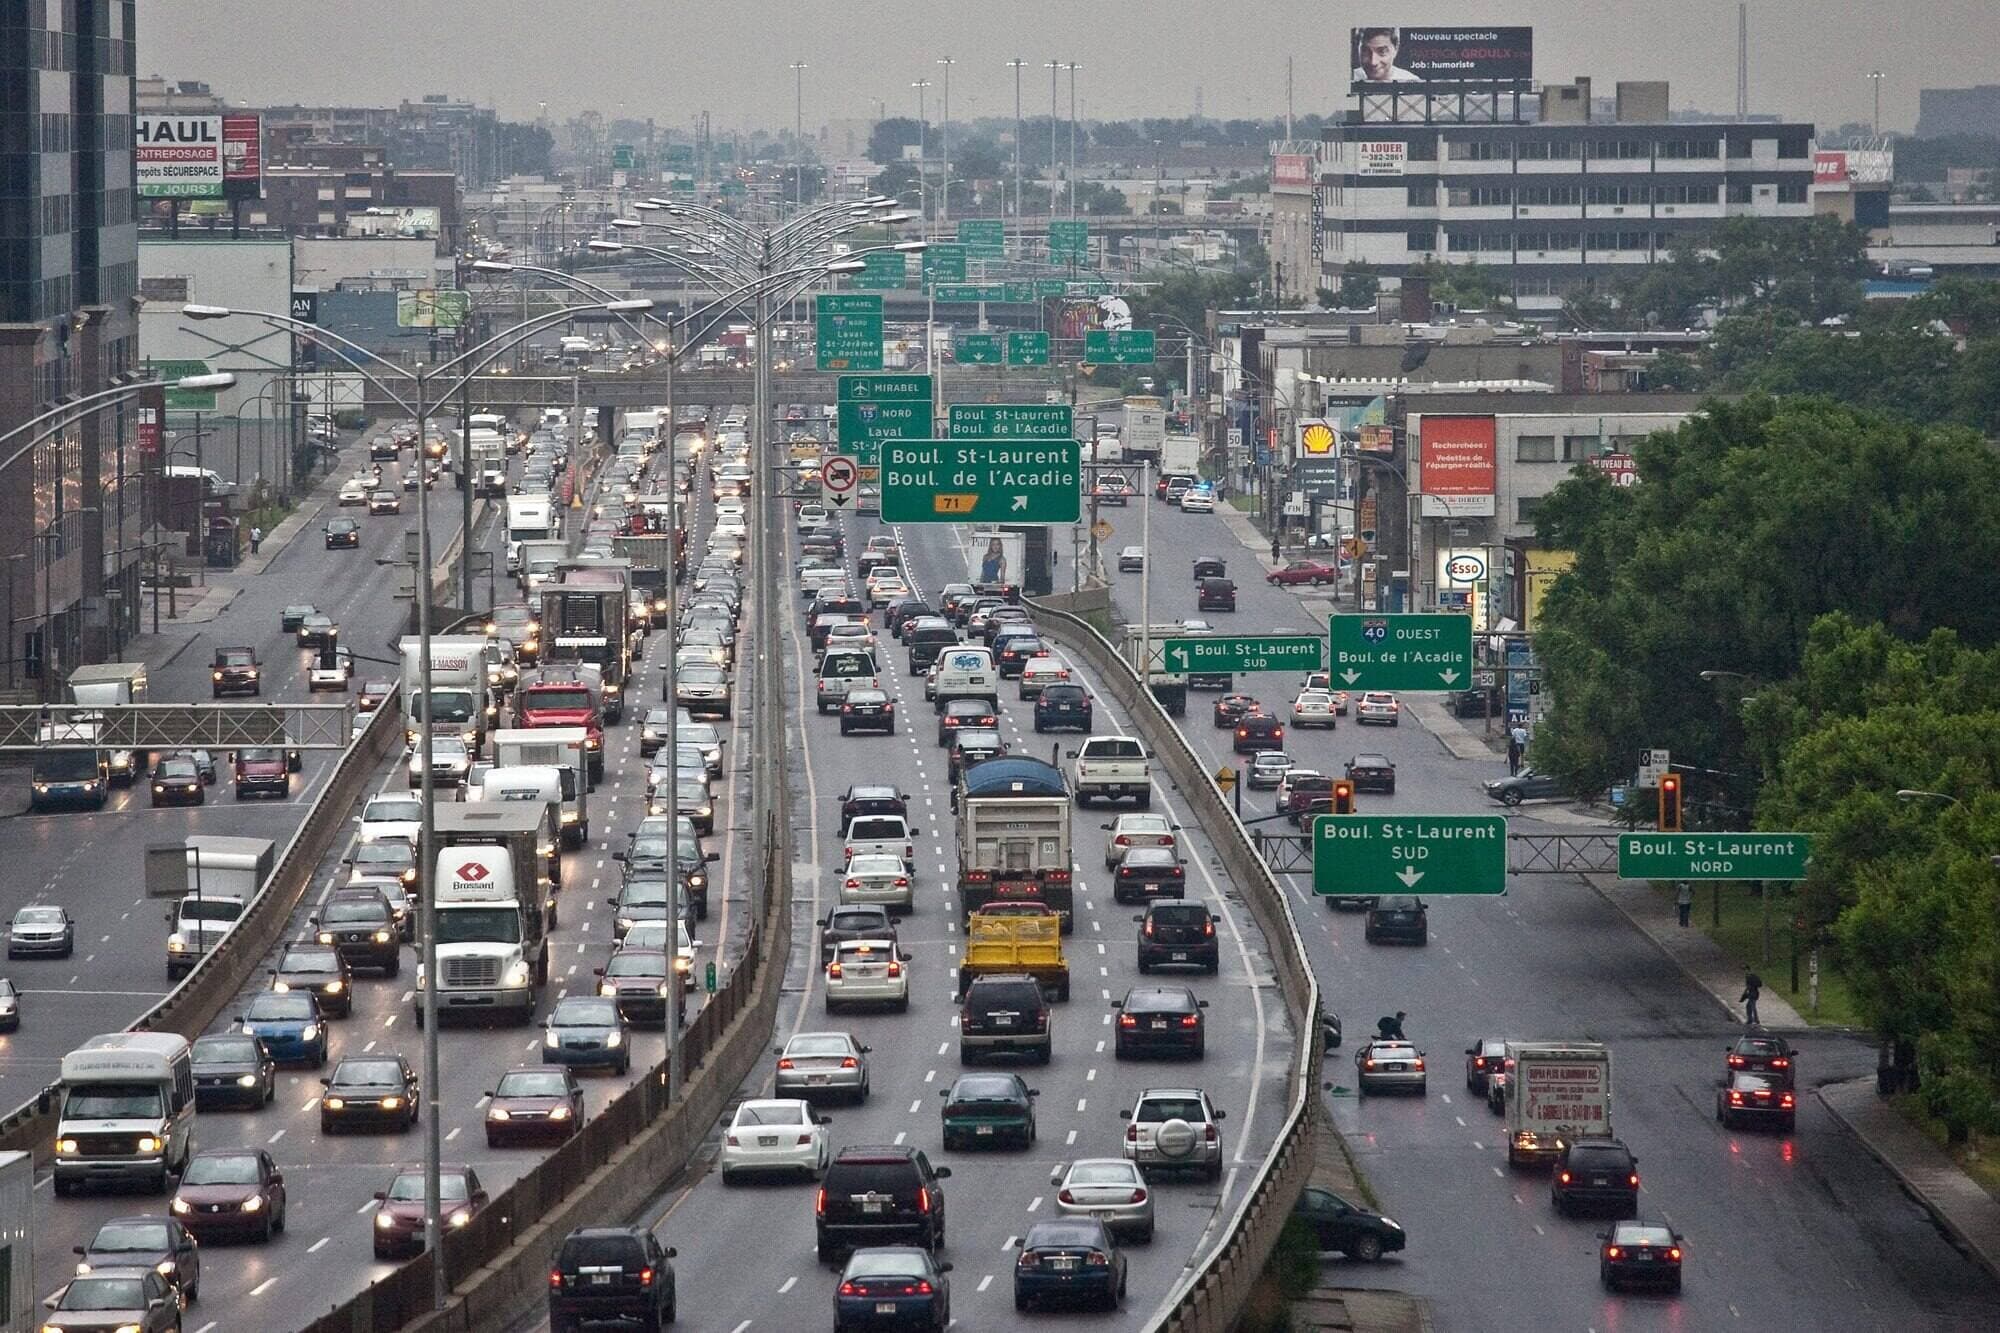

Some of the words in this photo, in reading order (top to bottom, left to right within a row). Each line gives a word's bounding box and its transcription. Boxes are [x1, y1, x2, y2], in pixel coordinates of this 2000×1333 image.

[1454, 31, 1498, 42] spectacle
[1461, 48, 1512, 59] GROULX
[1361, 144, 1368, 152] A
[1371, 144, 1402, 152] LOUER
[164, 184, 205, 194] JOURS
[874, 383, 920, 392] MIRABEL
[862, 410, 874, 418] 15
[882, 409, 912, 417] NORD
[995, 410, 1065, 421] St-Laurent
[868, 427, 902, 437] Laval
[953, 423, 985, 434] Boul.
[993, 423, 1009, 434] de
[1015, 422, 1068, 434] l'Acadie
[1229, 434, 1240, 445] 50
[892, 449, 944, 465] Boul.
[957, 448, 1069, 465] St-Laurent
[888, 471, 939, 486] Boul.
[953, 471, 978, 486] de
[989, 470, 1073, 486] l'Acadie
[943, 498, 960, 509] 71
[1365, 627, 1385, 638] 40
[1396, 629, 1441, 640] OUEST
[1195, 645, 1229, 656] Boul.
[1235, 643, 1315, 656] St-Laurent
[1338, 652, 1375, 663] Boul.
[1380, 652, 1397, 663] de
[1404, 651, 1463, 663] l'Acadie
[1244, 659, 1267, 668] SUD
[1482, 674, 1493, 684] 50
[1324, 824, 1372, 838] Boul.
[1382, 824, 1496, 839] St-Laurent
[1391, 847, 1429, 859] SUD
[1629, 841, 1677, 855] Boul.
[1684, 841, 1794, 856] St-Laurent
[1690, 861, 1733, 873] NORD
[453, 881, 494, 890] Brossard
